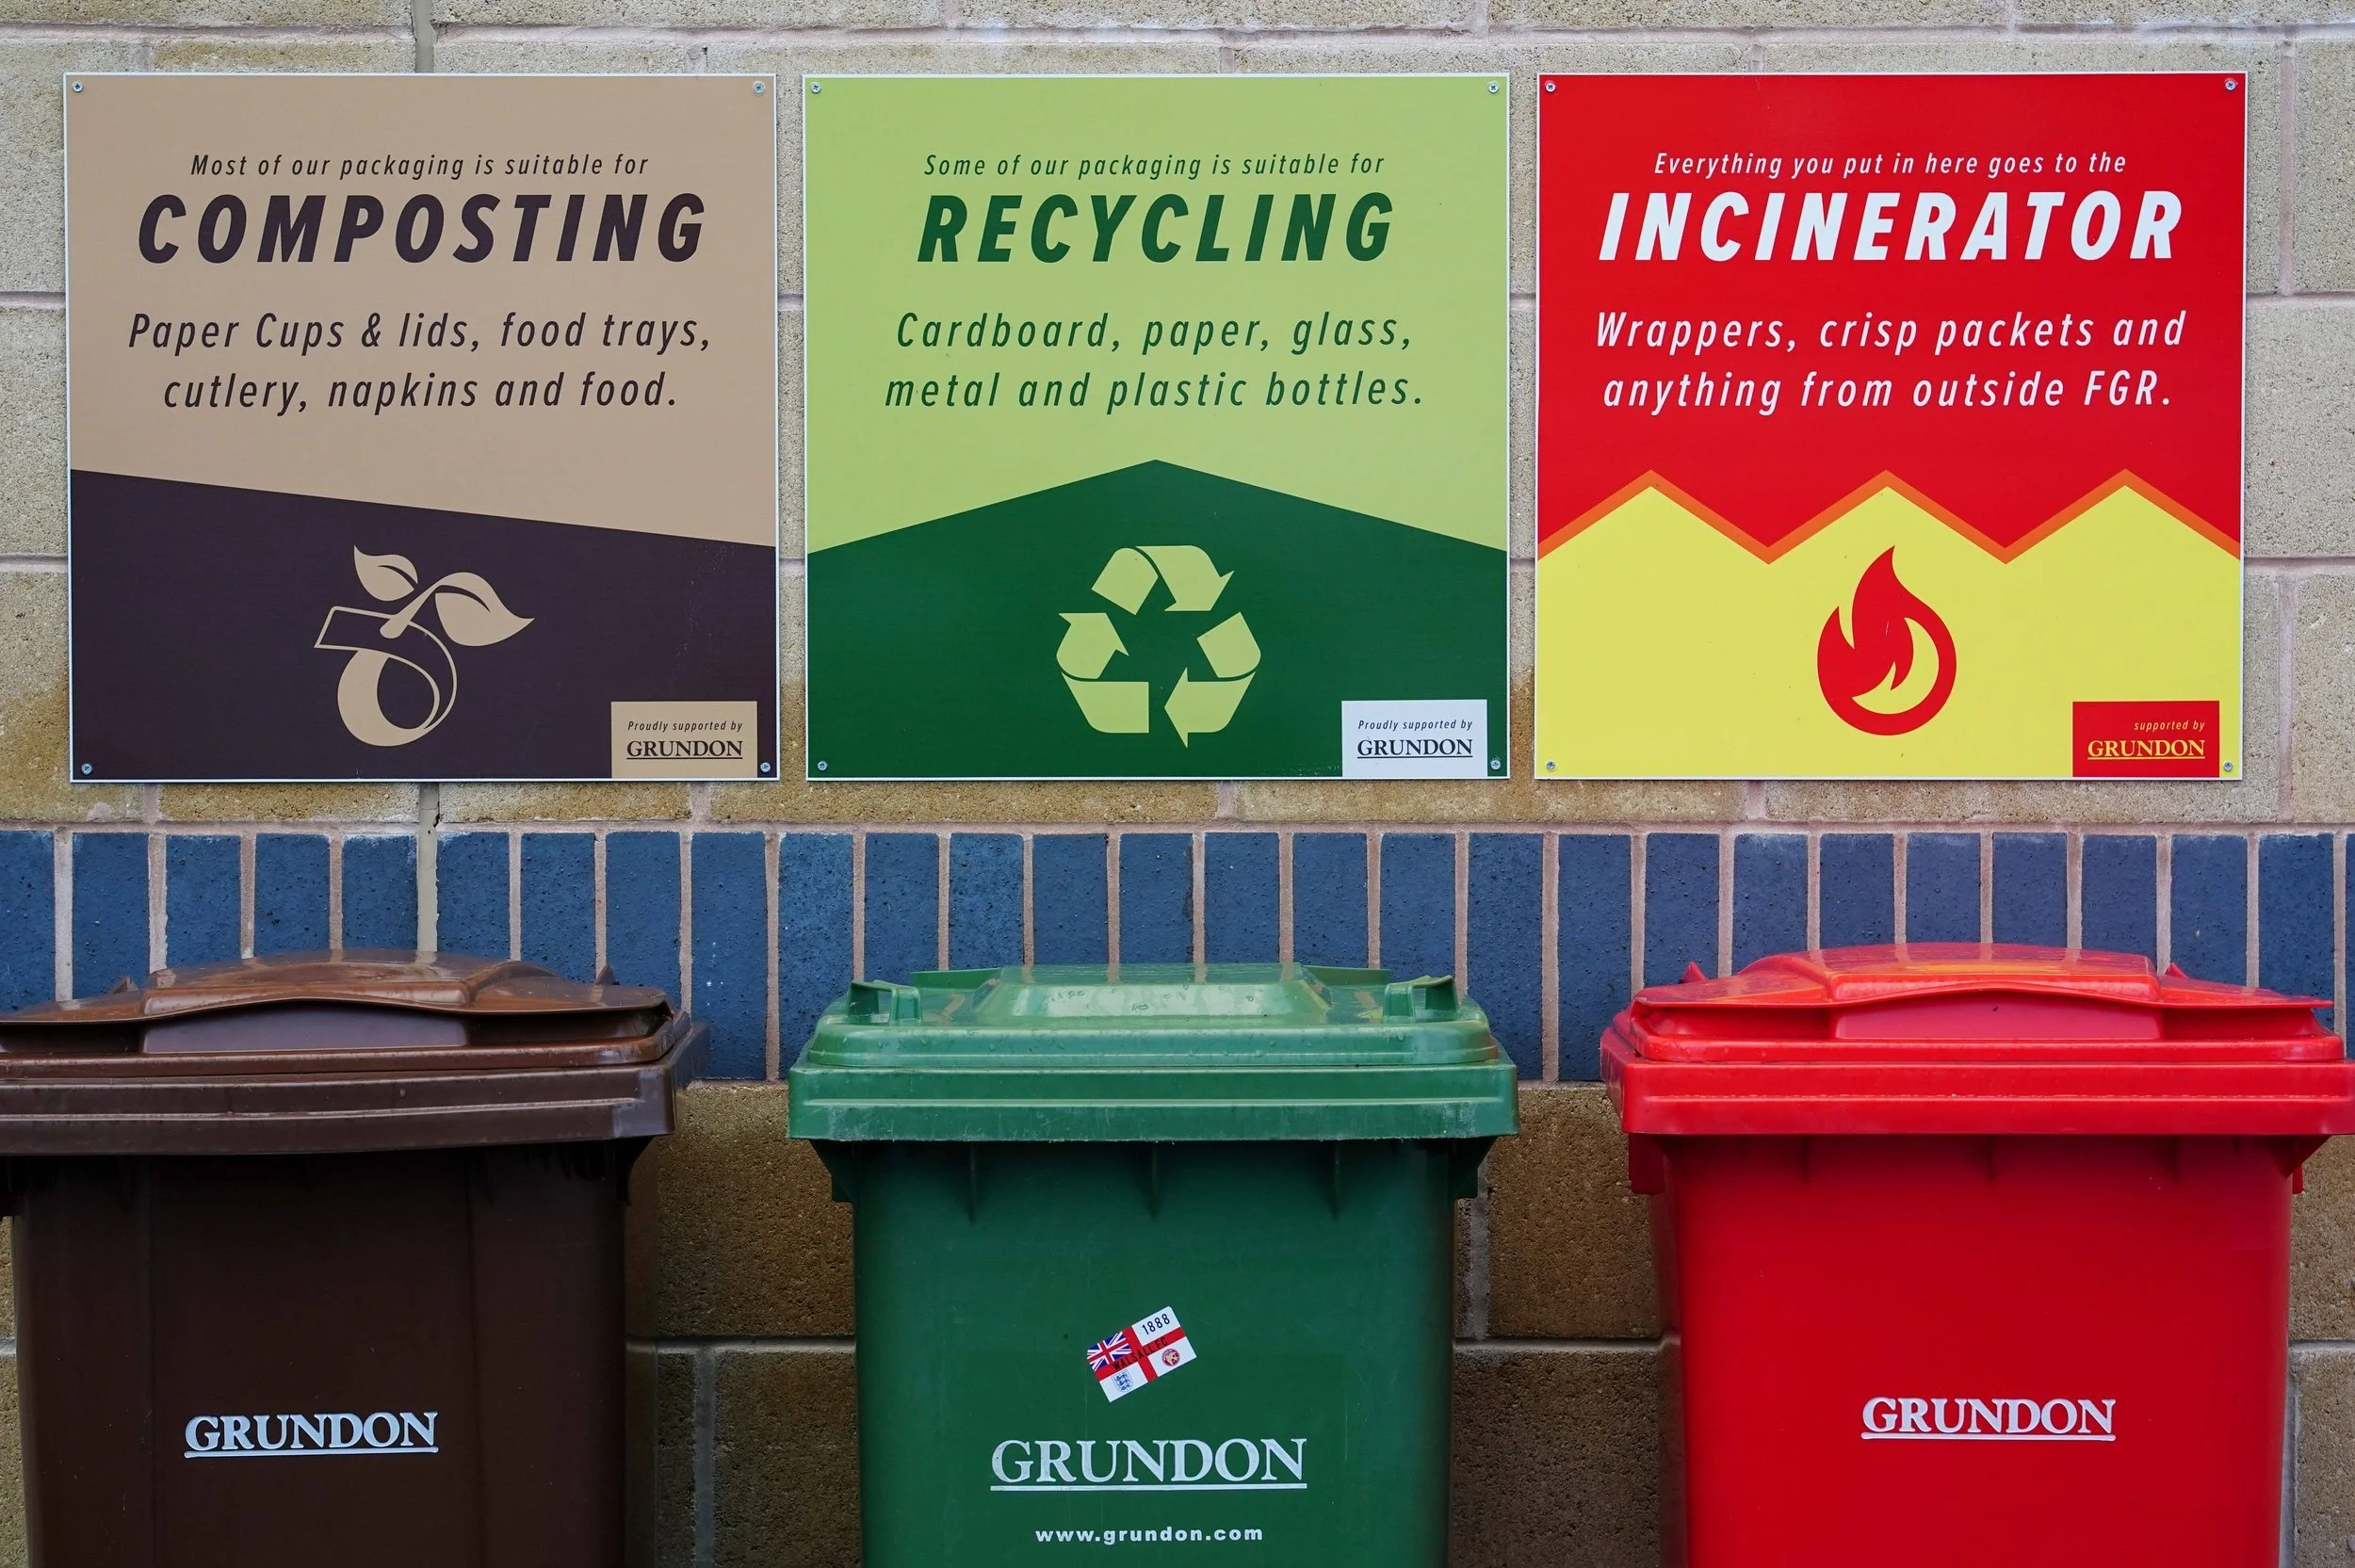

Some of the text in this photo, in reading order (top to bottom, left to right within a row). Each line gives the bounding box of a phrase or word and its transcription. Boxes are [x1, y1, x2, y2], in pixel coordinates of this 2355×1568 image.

[191, 154, 648, 180] Most of our packaging is suitable for
[924, 154, 1384, 180] Some of our packaging is suitable for
[1655, 152, 2125, 179] Everything you put in here goes to the
[139, 193, 704, 264] COMPOSTING
[918, 192, 1392, 263] RECYCLING
[1599, 190, 2182, 261] INCINERATOR
[129, 312, 708, 356] Paper Cups & lids, food trays,
[898, 312, 1409, 355] Cardboard, paper, glass,
[1598, 311, 2185, 355] Wrappers, crisp packets and
[165, 372, 674, 416] cutlery, napkins and food.
[885, 371, 1421, 414] metal and plastic bottles.
[1604, 370, 2168, 415] anything from outside FGR.
[628, 721, 742, 732] Proudly supported by
[1358, 719, 1472, 731] Proudly supported by
[2135, 720, 2204, 732] supported by
[626, 740, 742, 756] GRUNDON
[1357, 739, 1472, 755] GRUNDON
[2087, 739, 2205, 756] GRUNDON
[1142, 1314, 1170, 1334] 1888
[1113, 1346, 1153, 1371] WALSALL
[1862, 1397, 2116, 1433] GRUNDON
[185, 1412, 438, 1450] GRUNDON
[991, 1438, 1307, 1482] GRUNDON
[1035, 1527, 1262, 1545] www.grundon.com
